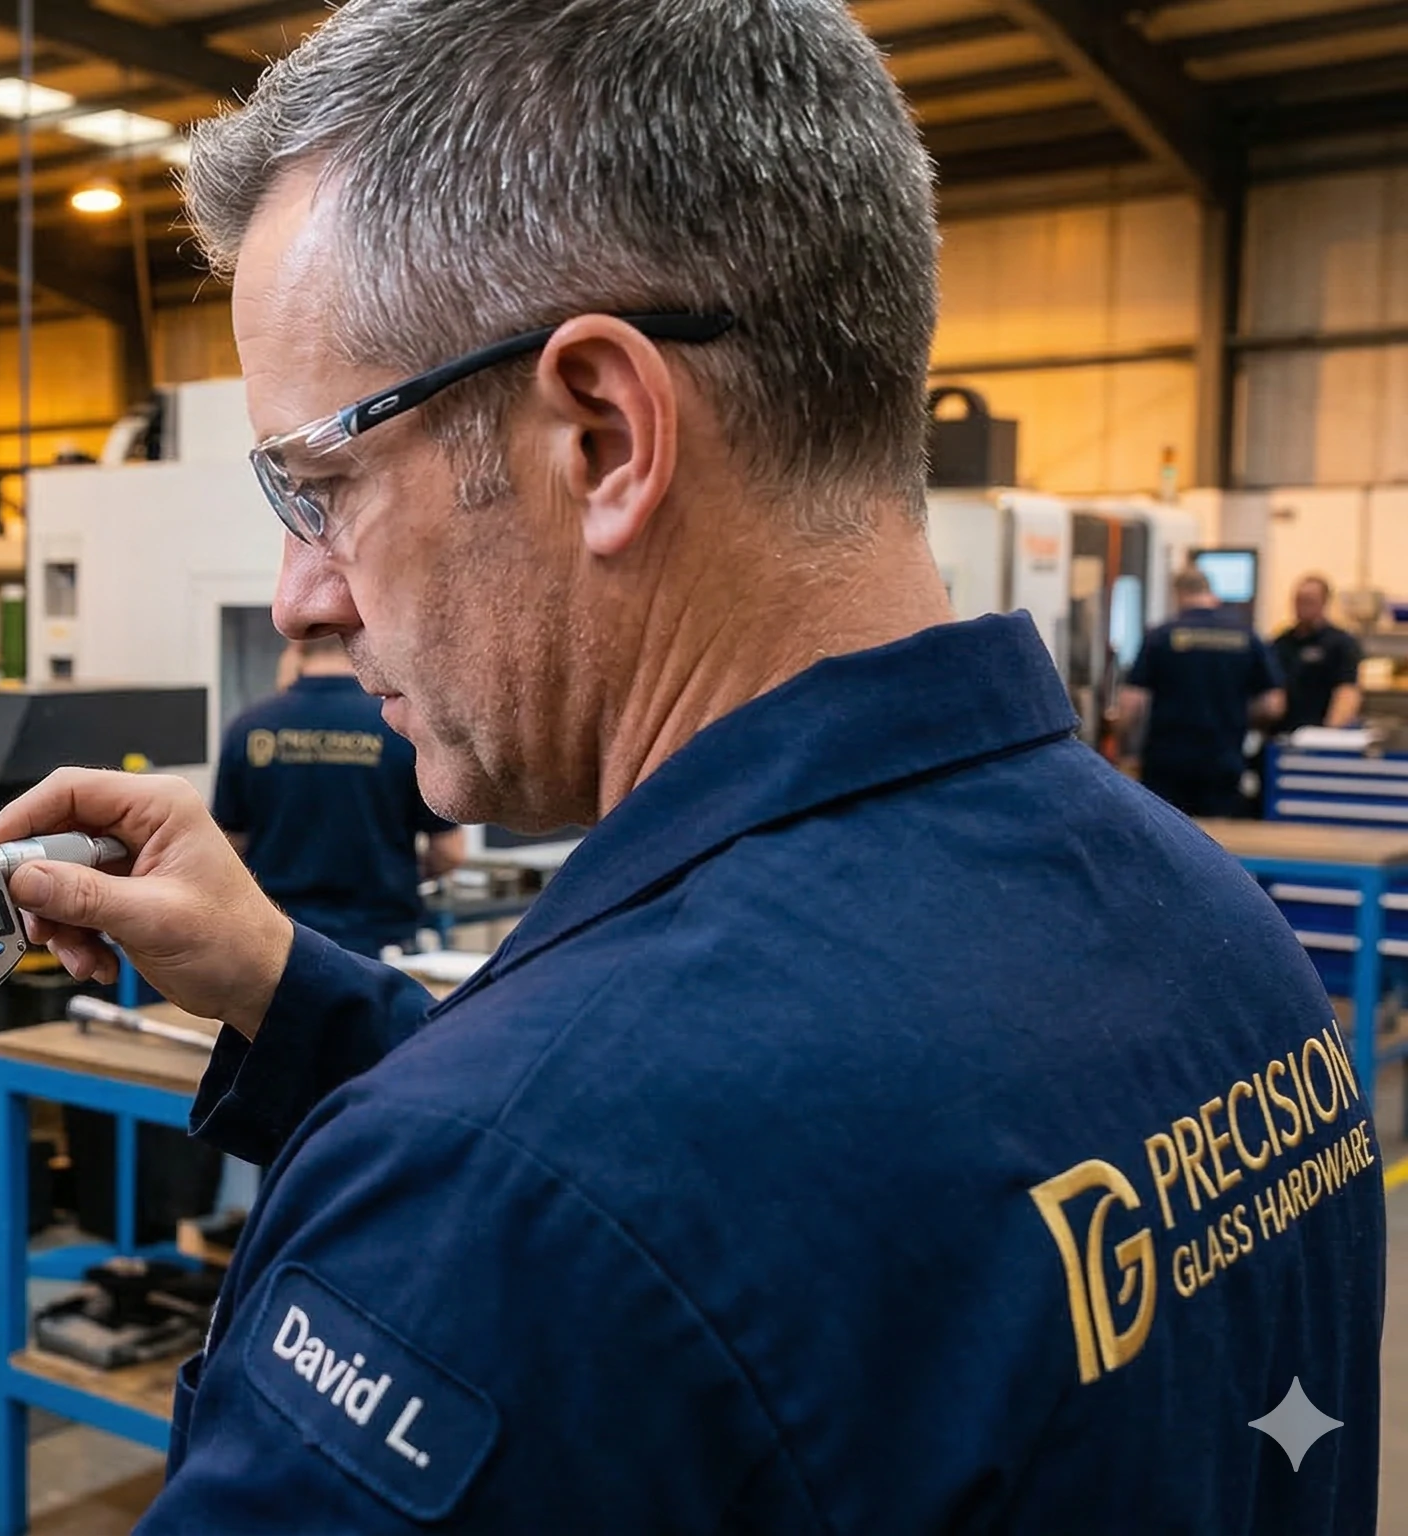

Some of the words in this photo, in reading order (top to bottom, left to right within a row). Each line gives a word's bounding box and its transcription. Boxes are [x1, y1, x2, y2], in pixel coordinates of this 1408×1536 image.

[1144, 1018, 1360, 1230] PRECISION
[1172, 1203, 1254, 1298] GLASS
[1253, 1119, 1375, 1240] HARDWARE
[272, 1304, 392, 1427] David
[385, 1396, 431, 1470] L.
